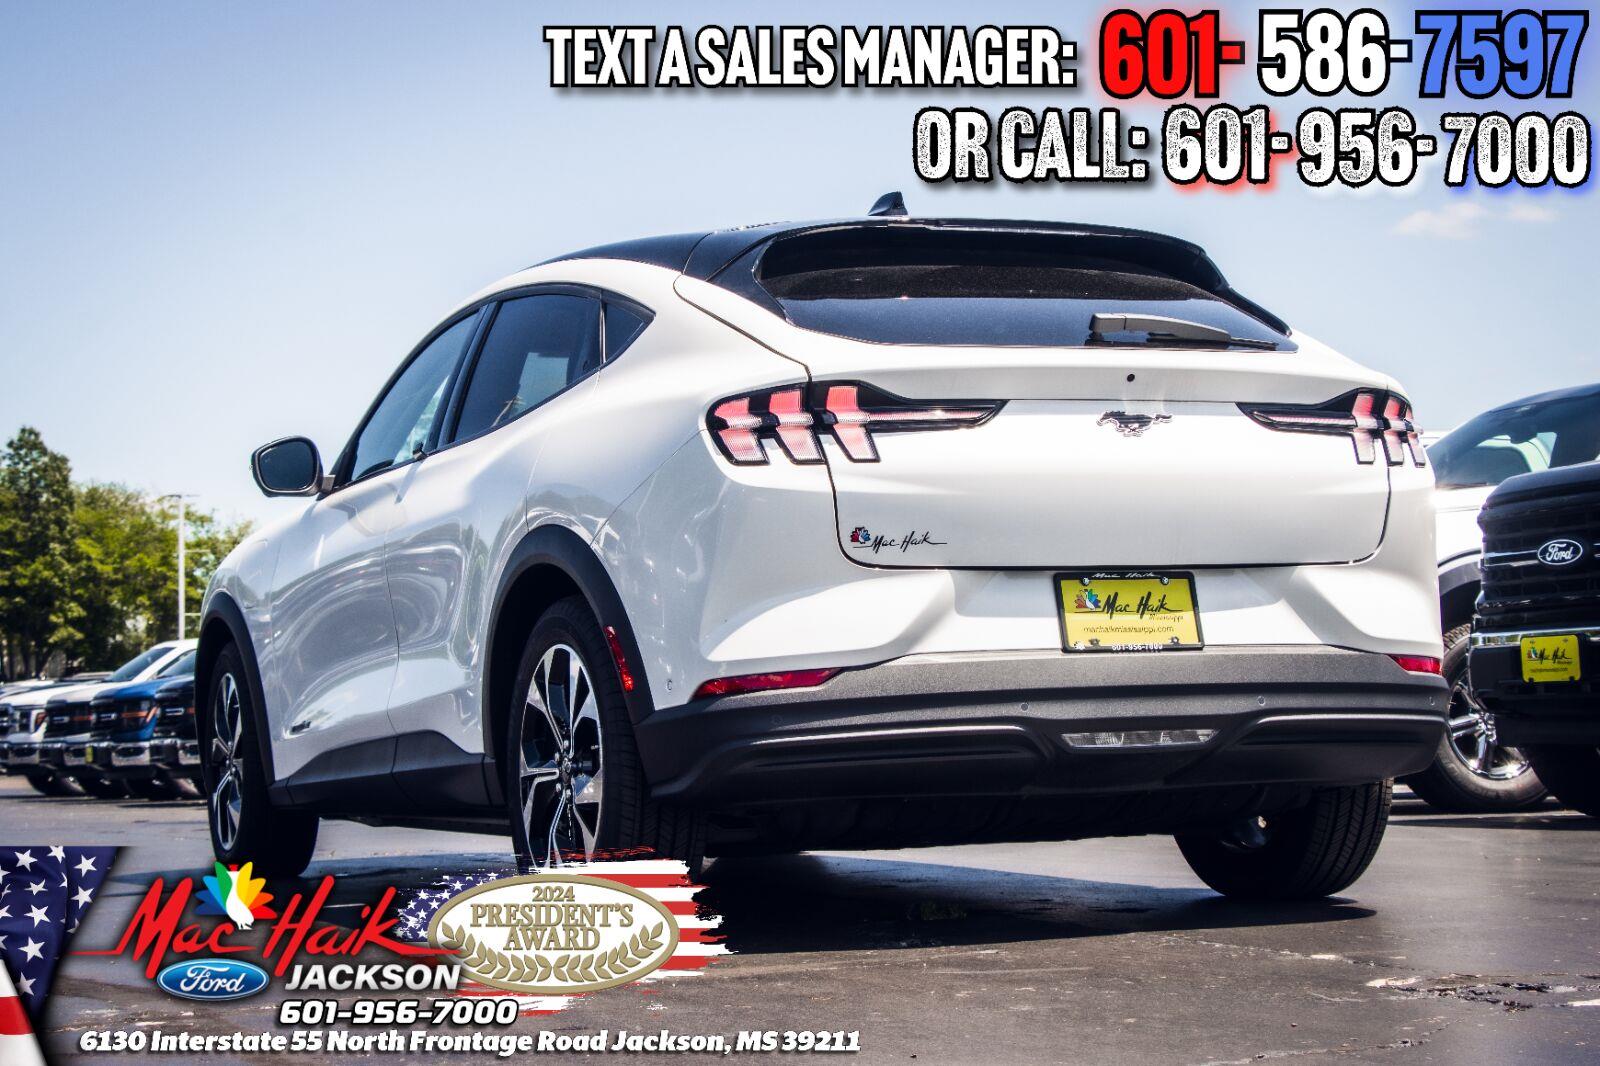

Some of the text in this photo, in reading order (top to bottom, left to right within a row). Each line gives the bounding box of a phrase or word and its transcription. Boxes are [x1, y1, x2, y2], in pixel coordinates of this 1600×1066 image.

[868, 531, 947, 554] Mac Haik
[1545, 543, 1574, 561] Ford
[1101, 591, 1183, 620] Mac Haik
